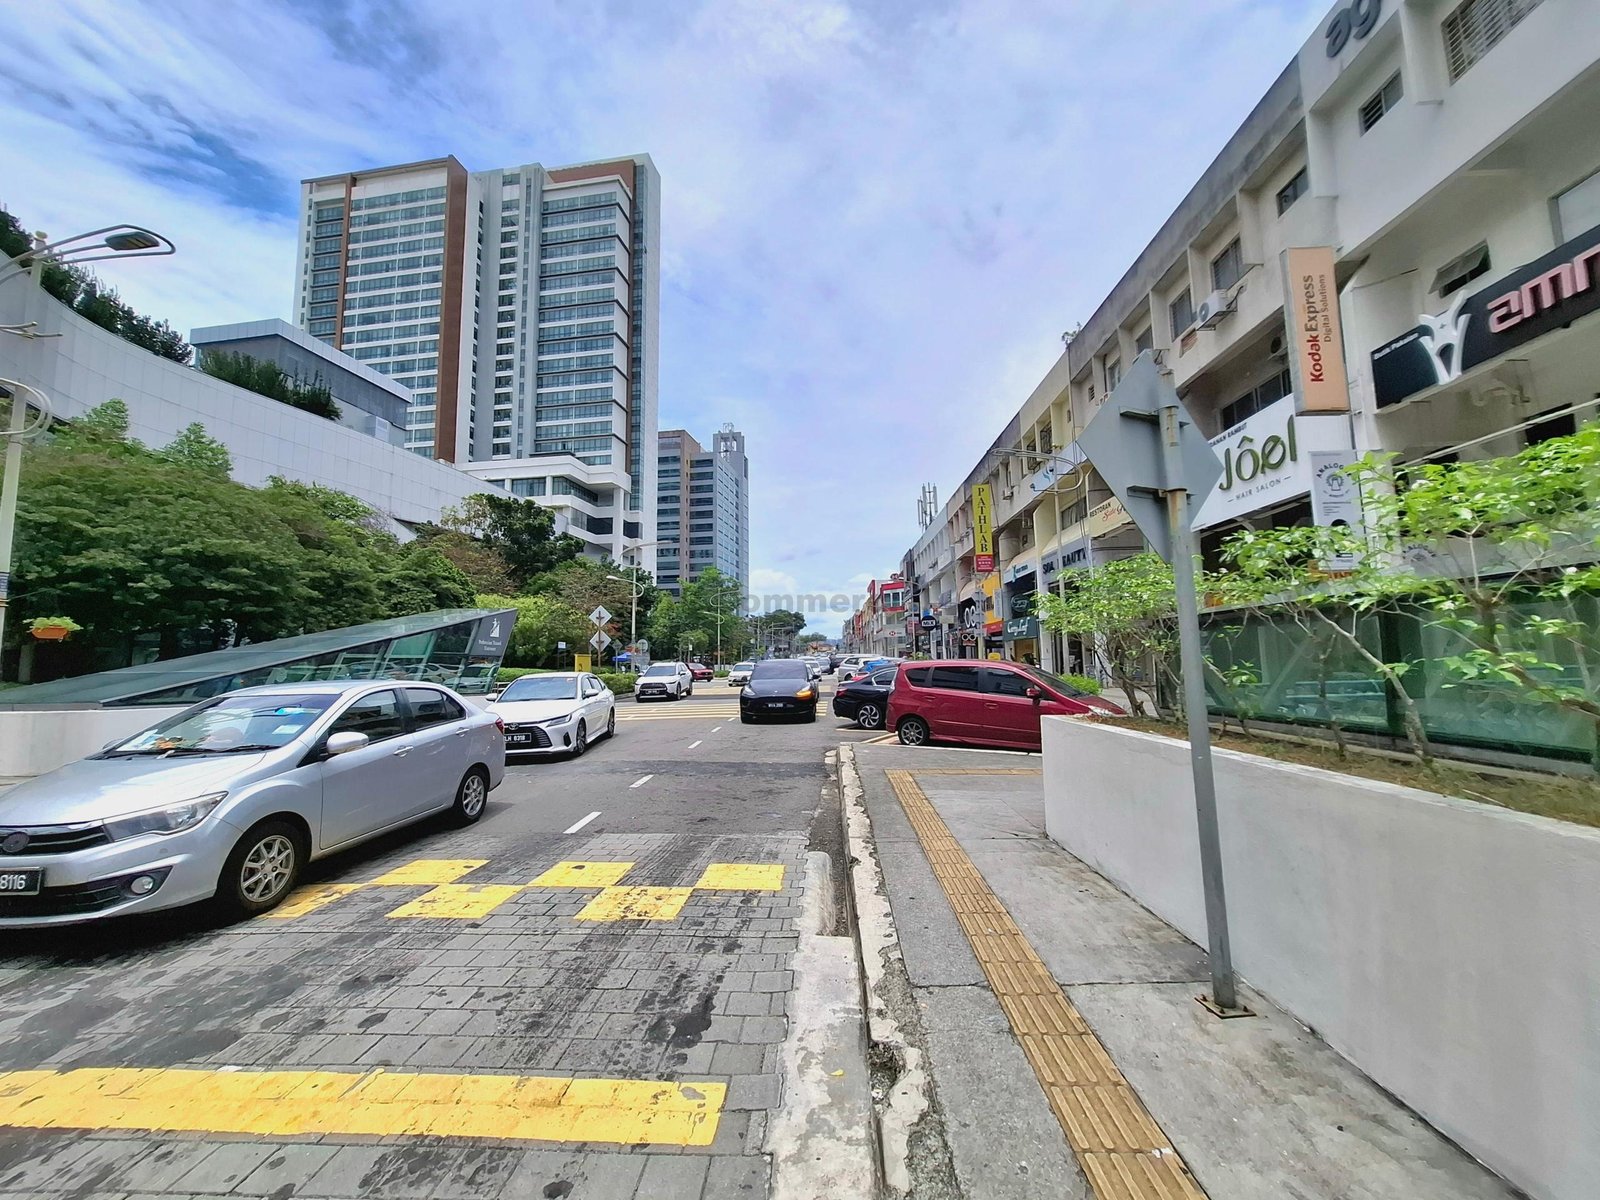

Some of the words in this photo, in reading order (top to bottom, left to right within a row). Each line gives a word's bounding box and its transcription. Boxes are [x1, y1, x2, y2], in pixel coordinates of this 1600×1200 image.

[1303, 274, 1320, 332] Express
[1319, 274, 1329, 313] Solutions
[1321, 315, 1332, 342] Digital
[1306, 334, 1324, 382] Kodak
[1236, 489, 1253, 500] HAIR
[1256, 478, 1281, 493] SALON
[977, 487, 988, 553] PATHLAB
[0, 874, 26, 890] 8116
